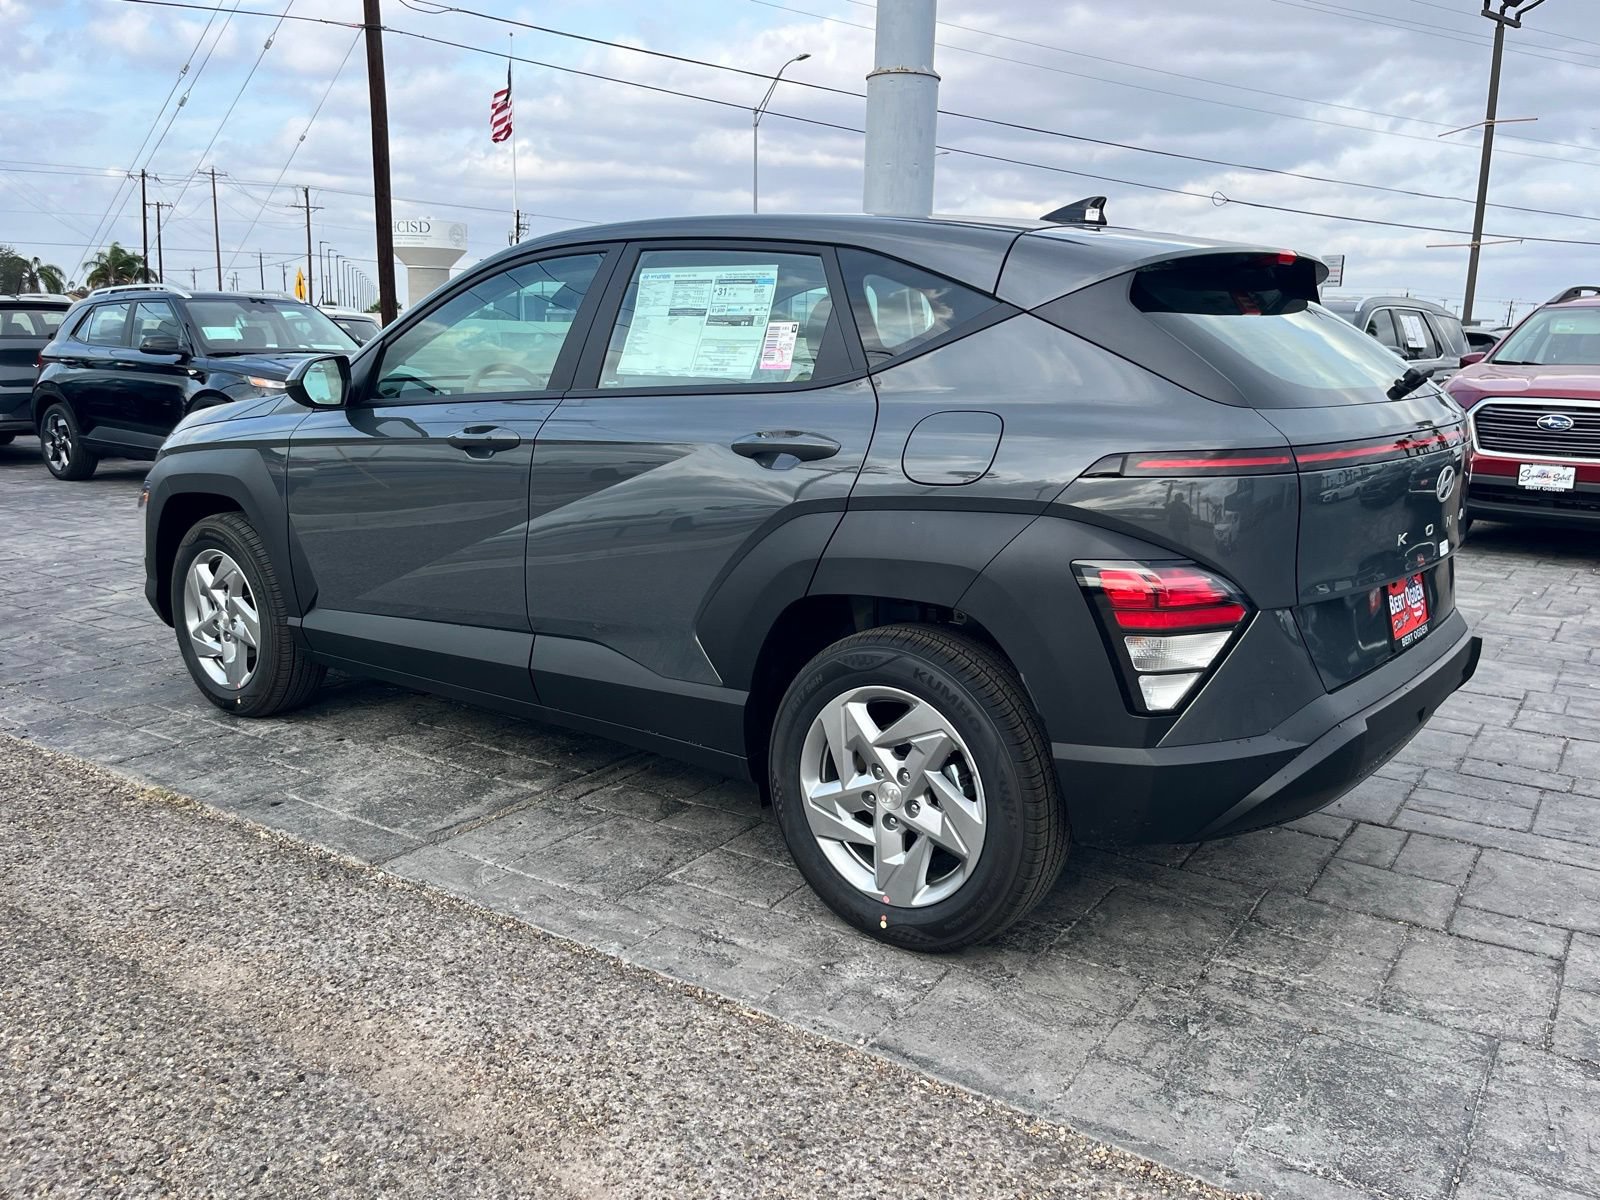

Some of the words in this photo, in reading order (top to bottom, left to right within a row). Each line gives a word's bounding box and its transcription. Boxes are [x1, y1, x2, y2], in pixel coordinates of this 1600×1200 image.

[717, 287, 728, 297] 31
[1389, 592, 1406, 616] BERT
[1405, 583, 1424, 605] OGDEN
[1401, 632, 1413, 647] BERT
[1413, 624, 1428, 639] OGDEN
[912, 667, 984, 734] KUMHO
